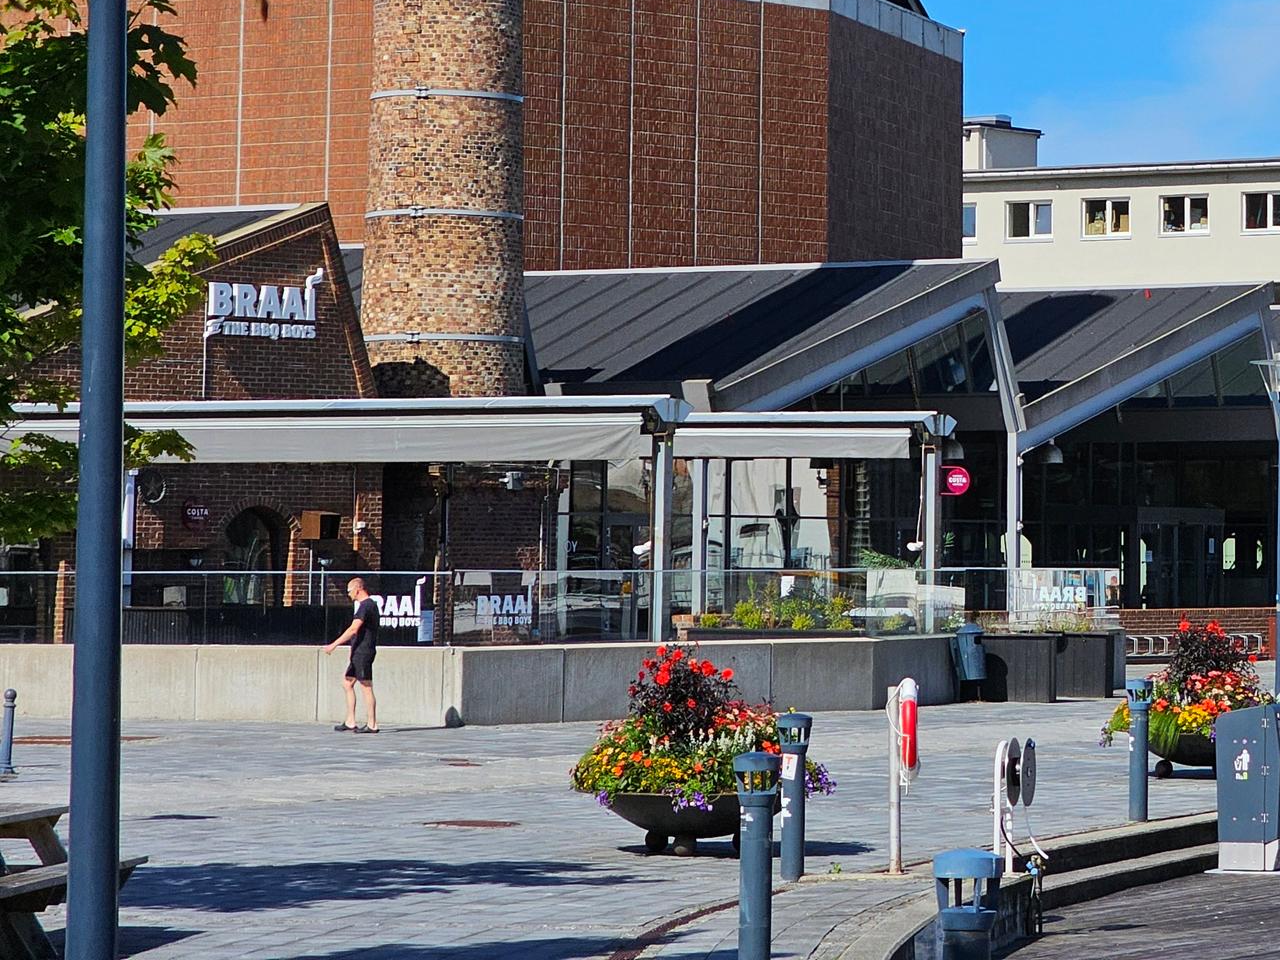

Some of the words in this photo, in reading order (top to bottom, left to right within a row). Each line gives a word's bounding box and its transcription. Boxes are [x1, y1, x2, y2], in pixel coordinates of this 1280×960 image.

[207, 274, 319, 321] BRAAI
[222, 321, 249, 336] THE
[250, 322, 280, 340] BBQ
[281, 324, 316, 339] BOYS
[186, 508, 209, 516] COSTA
[356, 584, 421, 616] RAAI
[477, 585, 533, 616] BRAAI
[379, 617, 398, 629] BBQ
[398, 617, 421, 627] BOYS
[498, 615, 513, 627] BBQ
[514, 615, 532, 625] BOYS
